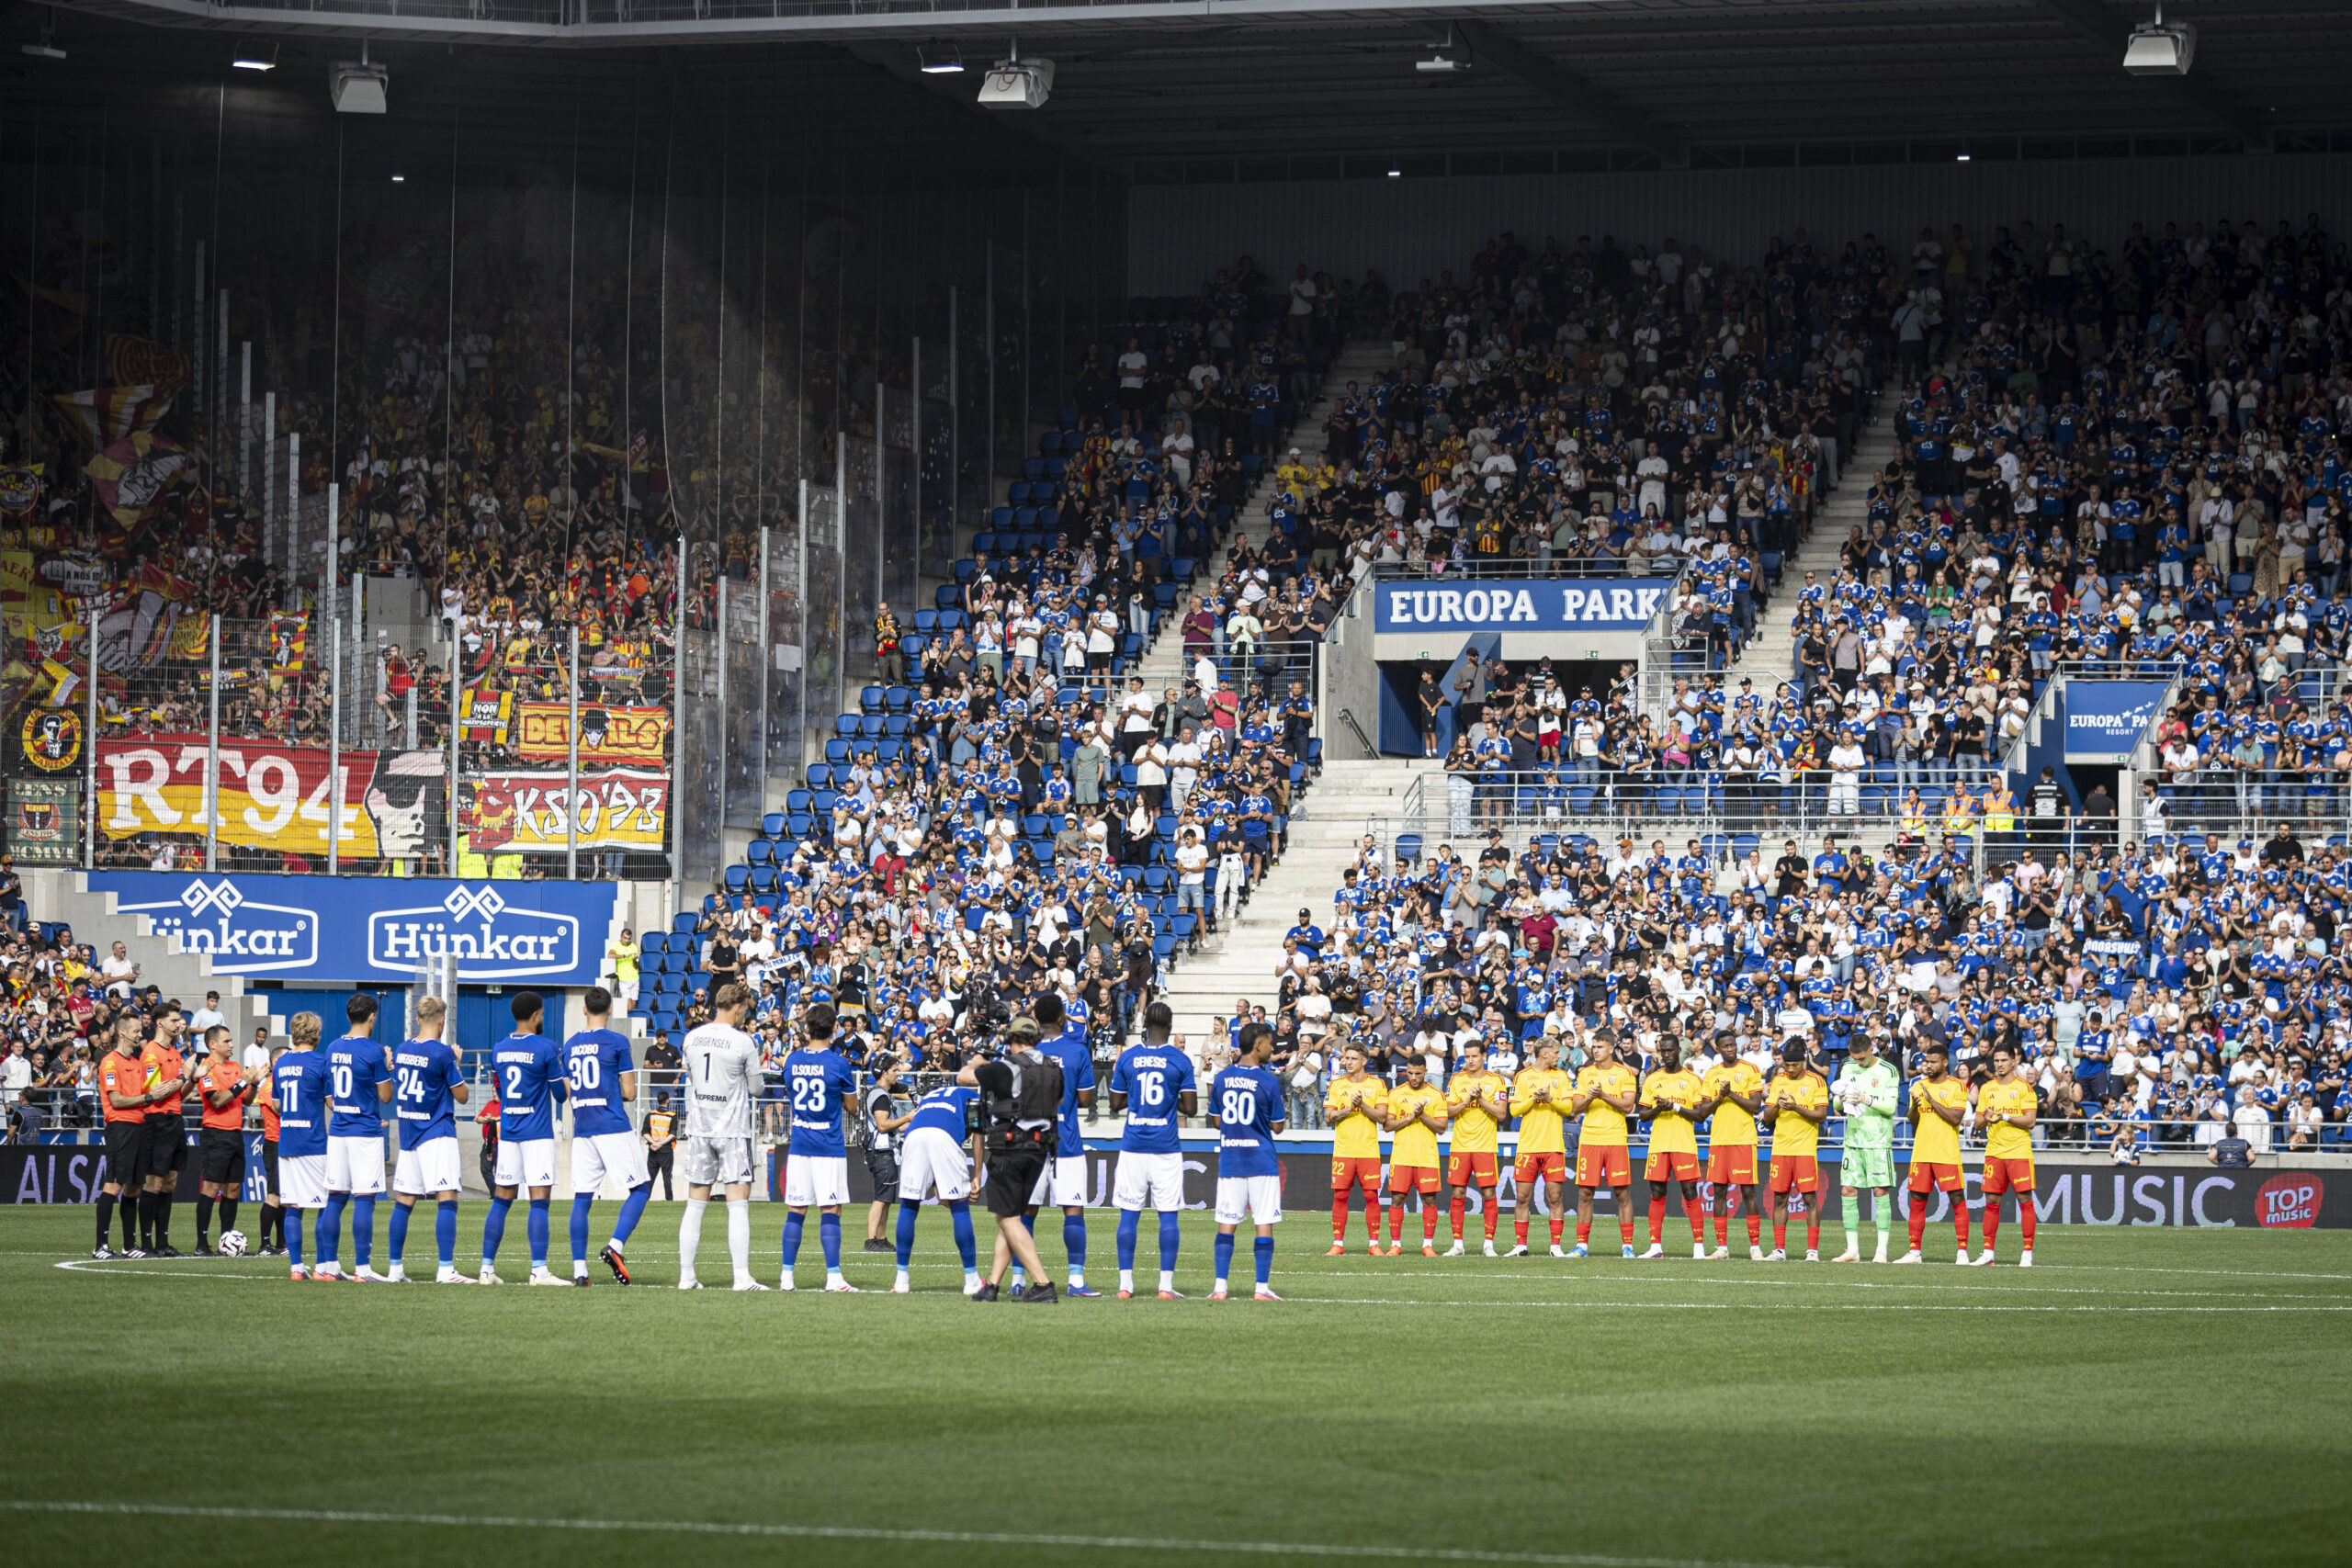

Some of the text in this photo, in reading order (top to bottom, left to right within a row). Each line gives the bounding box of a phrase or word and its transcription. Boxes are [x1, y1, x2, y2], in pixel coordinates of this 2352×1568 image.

[1389, 587, 1660, 624] EUROPA PARK
[473, 703, 498, 714] NON
[2069, 714, 2152, 728] EUROPA PA
[105, 745, 359, 841] RT94
[150, 918, 299, 955] ünkar
[384, 919, 560, 961] Hünkar
[571, 1043, 599, 1057] JACOBO
[1133, 1055, 1168, 1069] GENESIS
[331, 1066, 353, 1099] 10
[506, 1066, 522, 1100] 2
[568, 1055, 601, 1091] 30
[704, 1052, 711, 1083] 1
[791, 1065, 824, 1077] D.SOUSA
[280, 1079, 299, 1112] 11
[397, 1066, 425, 1103] 24
[792, 1077, 827, 1112] 23
[1136, 1071, 1164, 1106] 16
[1224, 1077, 1259, 1092] YASSINE
[1222, 1089, 1256, 1126] 80
[1332, 1161, 1345, 1176] 22
[1516, 1154, 1530, 1168] 27
[1579, 1157, 1588, 1171] 3
[2016, 1174, 2236, 1227] MUSIC
[2264, 1185, 2314, 1211] TOP
[2266, 1205, 2312, 1225] music
